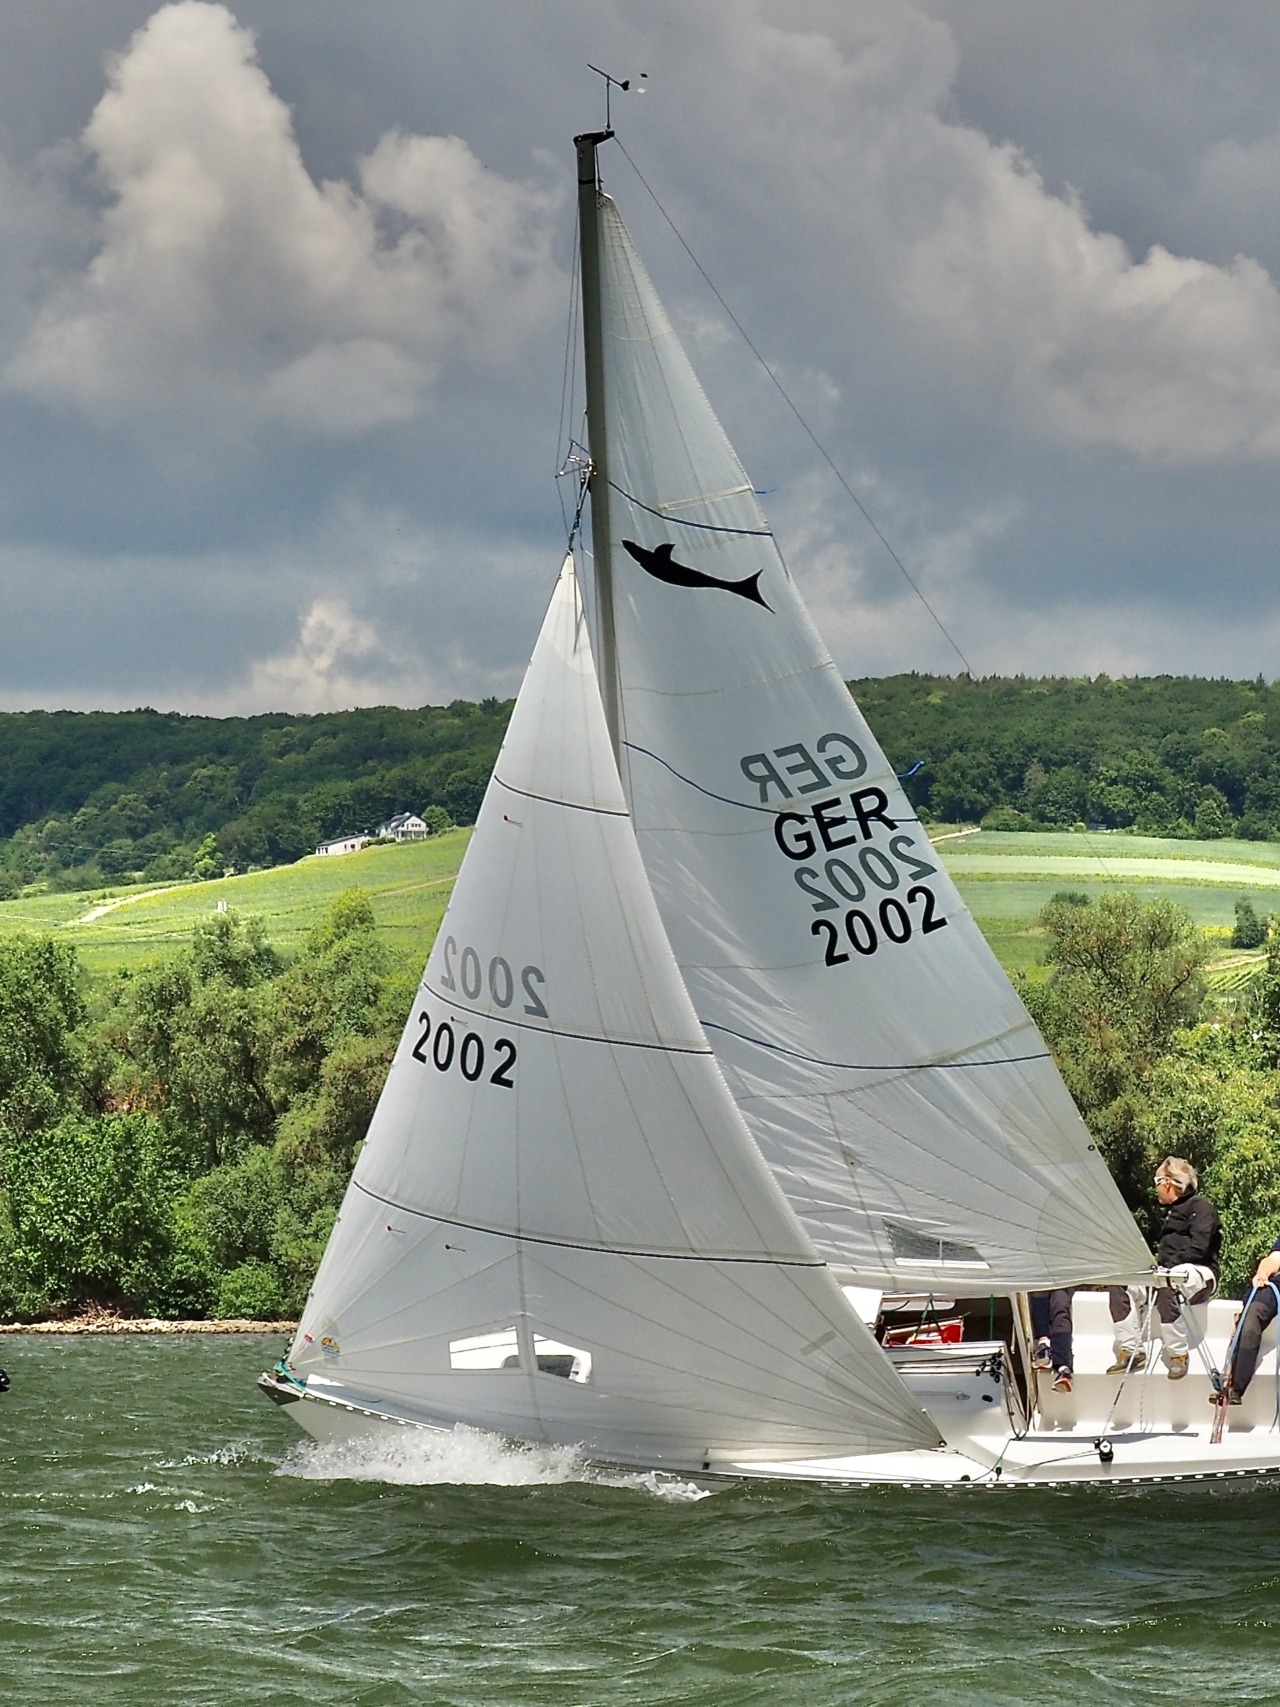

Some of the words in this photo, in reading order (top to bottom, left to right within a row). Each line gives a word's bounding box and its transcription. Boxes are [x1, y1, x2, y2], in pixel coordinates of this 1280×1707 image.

[773, 786, 899, 861] GER
[811, 885, 948, 967] 2002
[412, 1011, 517, 1089] 2002
